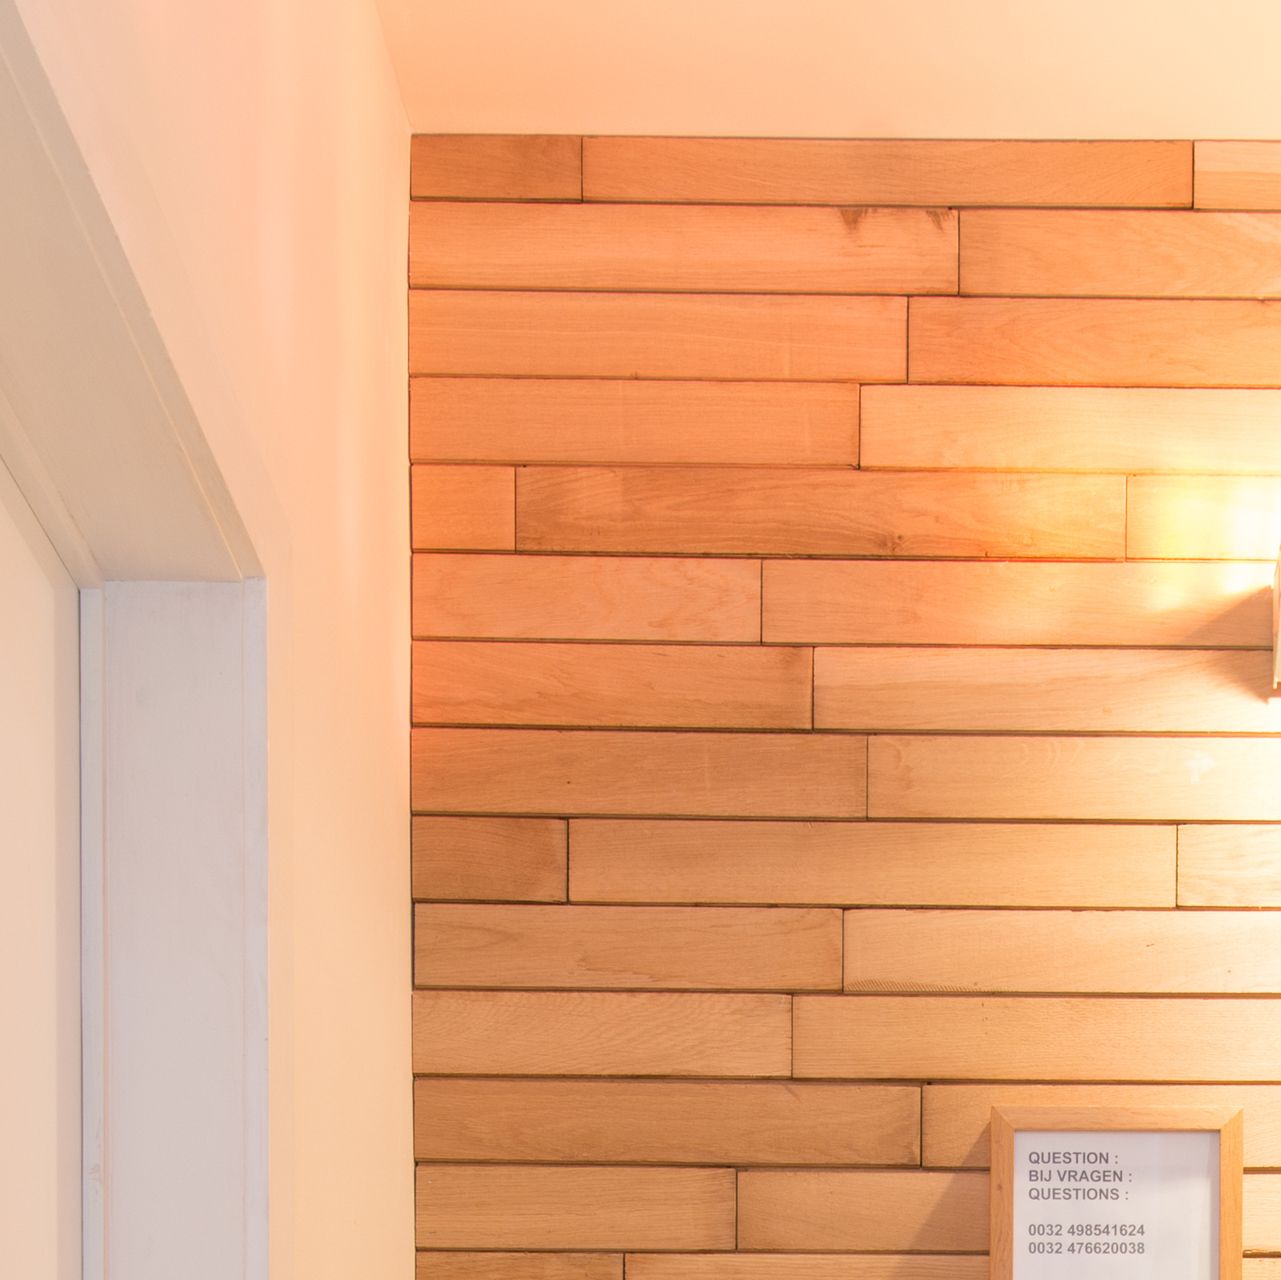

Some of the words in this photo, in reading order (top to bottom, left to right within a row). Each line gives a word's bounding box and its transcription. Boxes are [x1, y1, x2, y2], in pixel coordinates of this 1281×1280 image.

[1028, 1152, 1109, 1165] QUESTION
[1029, 1170, 1052, 1182] BIJ
[1056, 1170, 1123, 1182] VRAGEN
[1028, 1188, 1120, 1200] QUESTIONS
[1028, 1224, 1063, 1236] 0032
[1067, 1224, 1145, 1236] 498541624
[1028, 1242, 1063, 1254] 0032
[1067, 1242, 1145, 1254] 476620038
